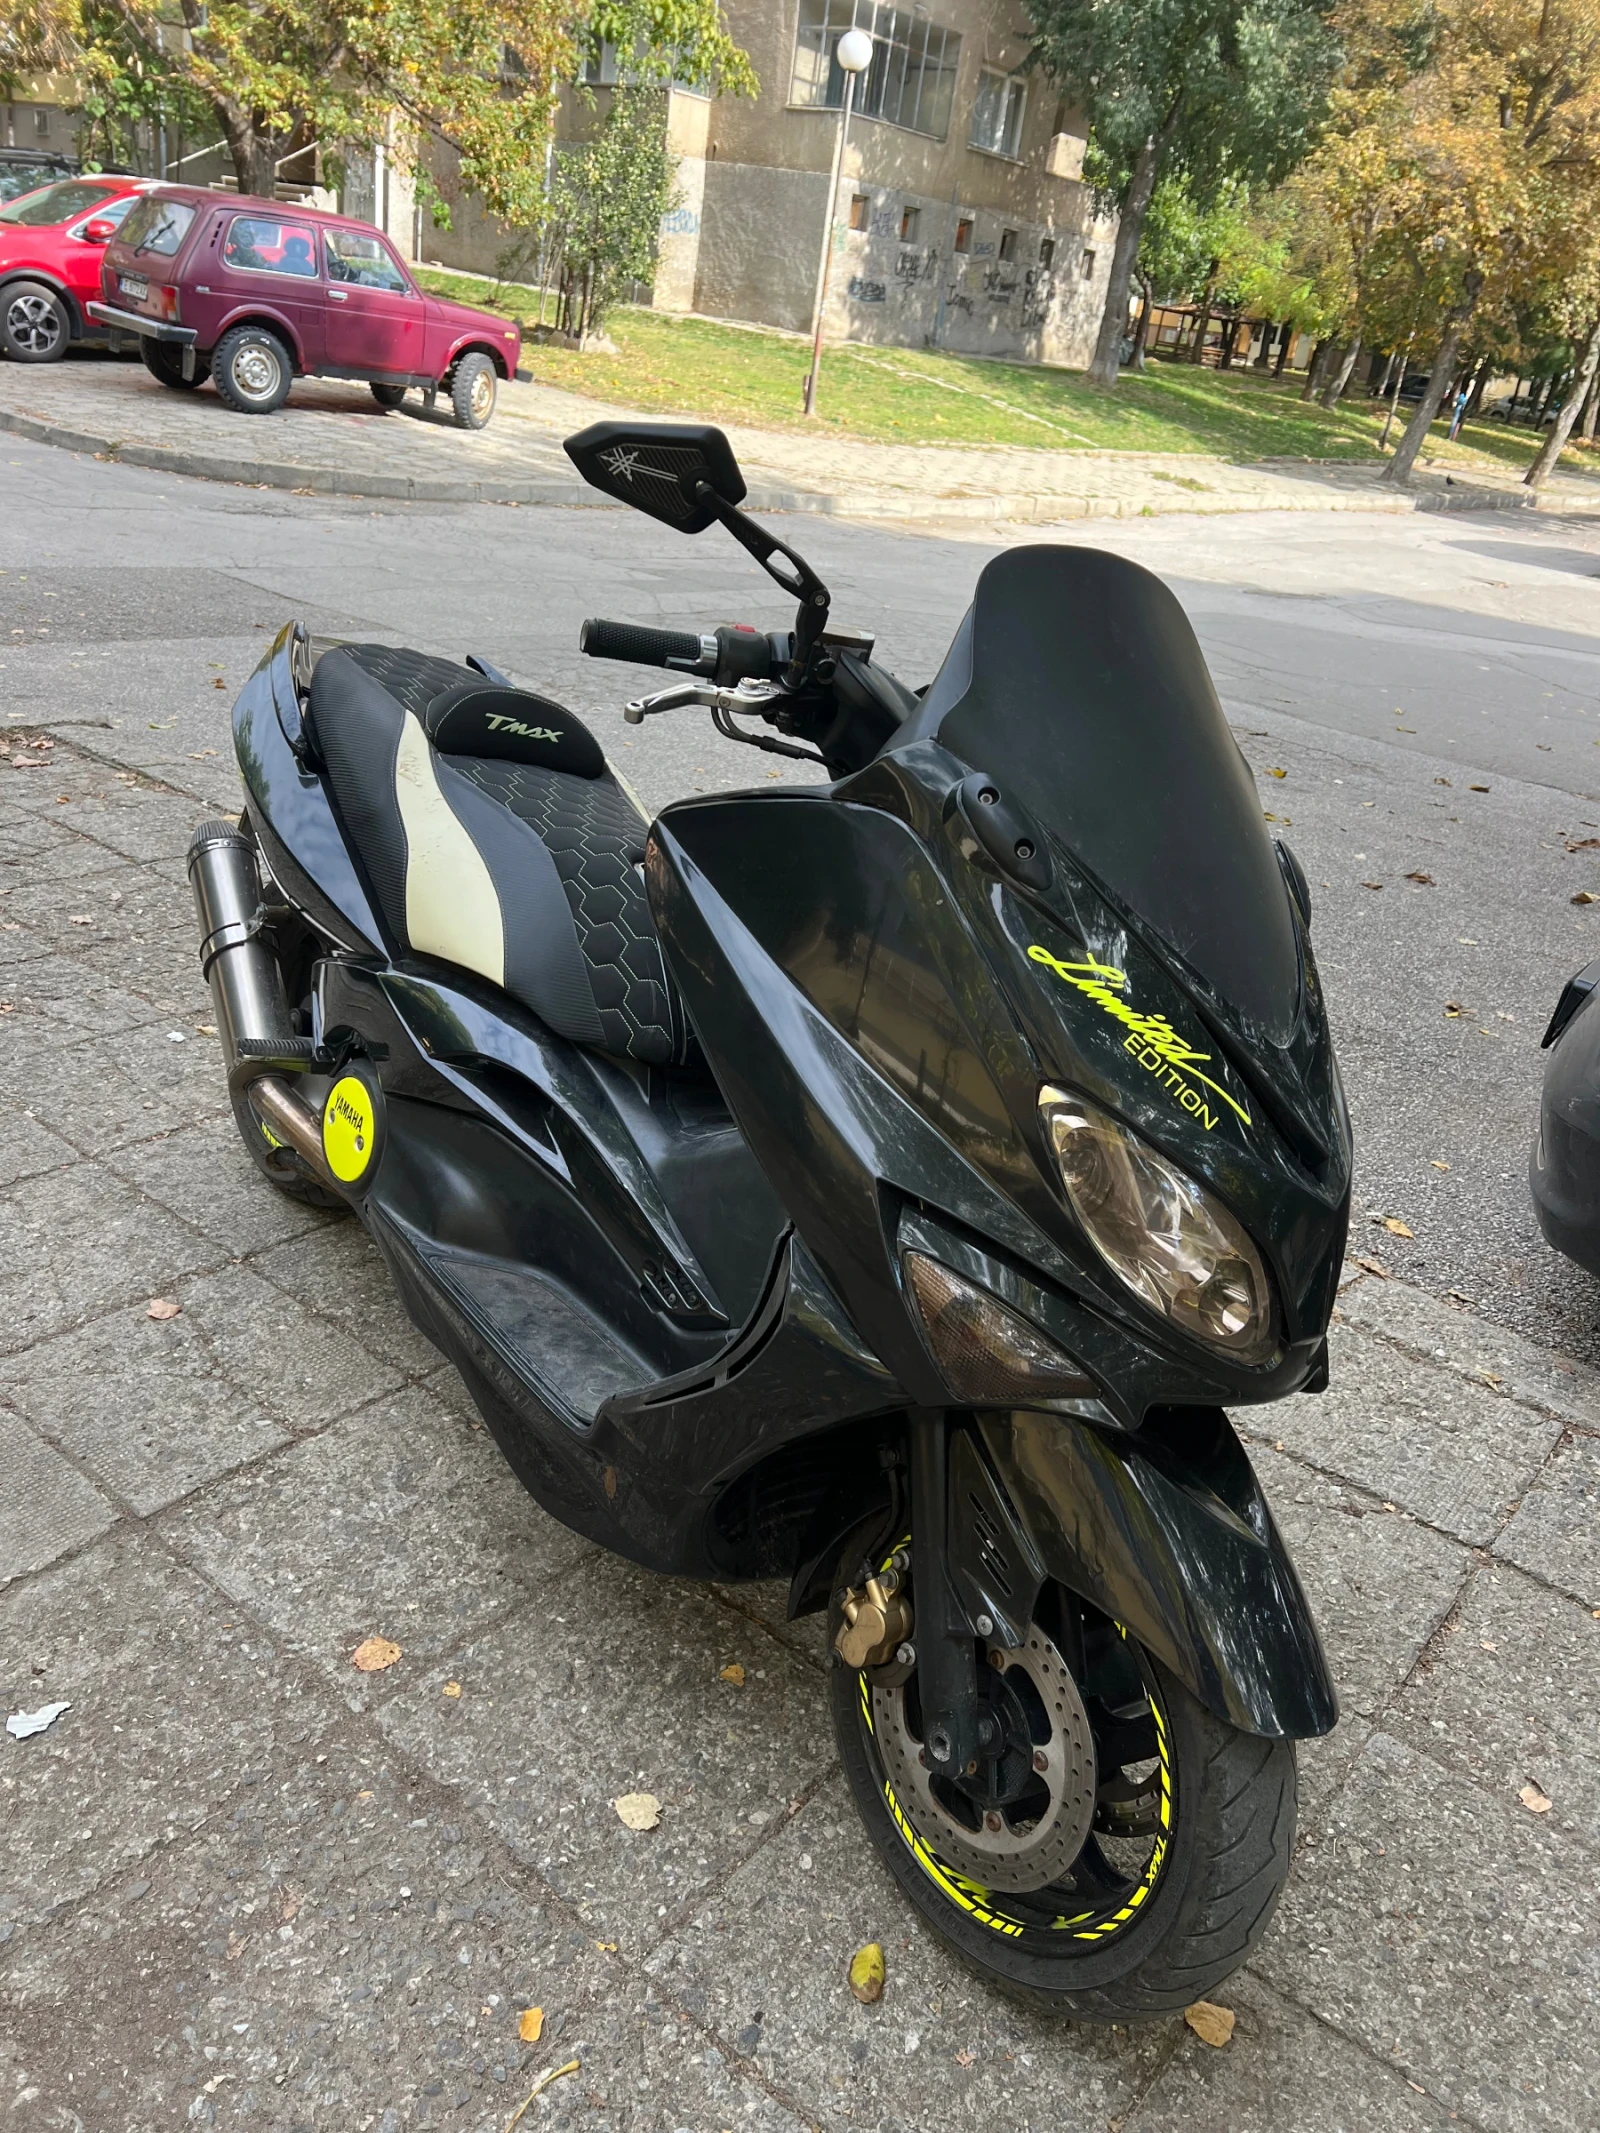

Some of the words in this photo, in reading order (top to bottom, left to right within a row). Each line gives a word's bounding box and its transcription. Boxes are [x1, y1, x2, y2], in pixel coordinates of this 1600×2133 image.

[1027, 945, 1252, 1125] Limited
[1122, 1032, 1220, 1131] EDITION
[335, 1093, 364, 1133] YAMAHA
